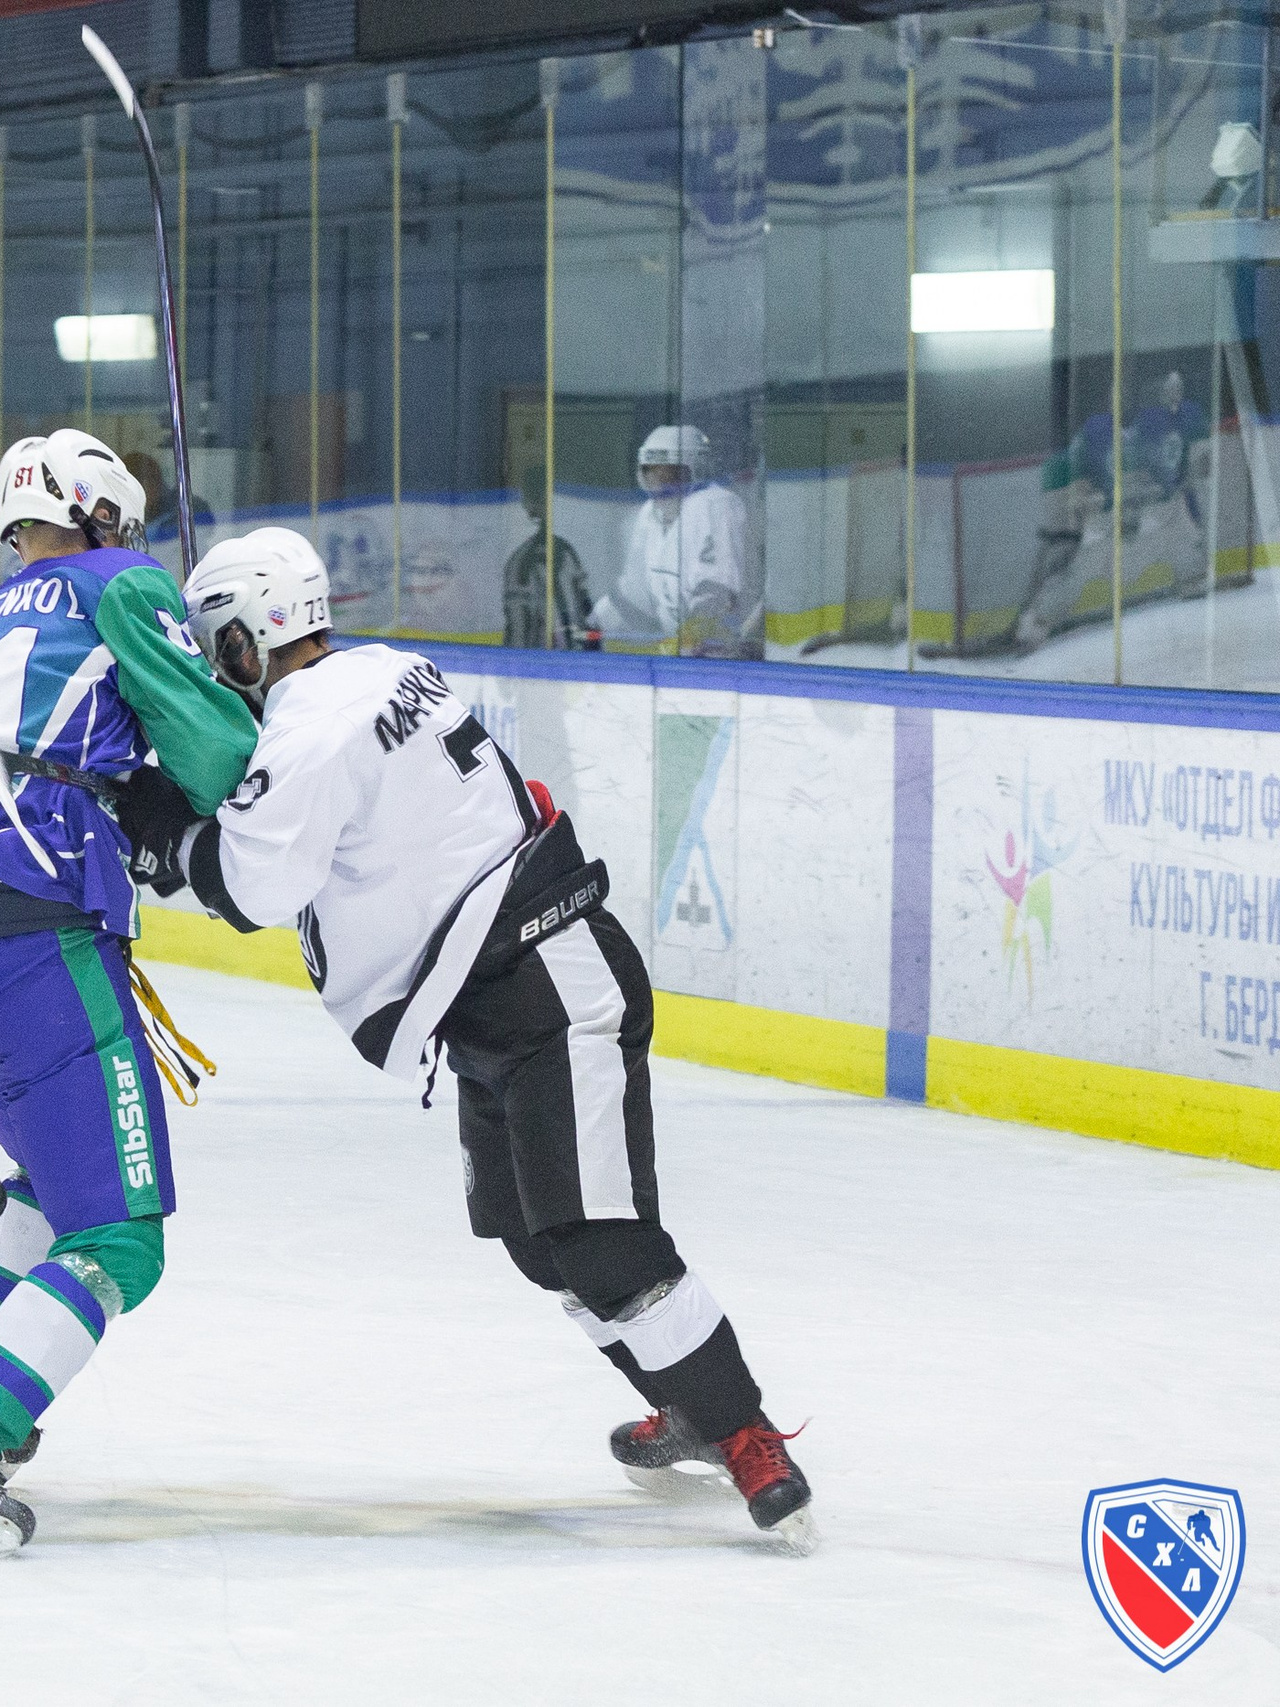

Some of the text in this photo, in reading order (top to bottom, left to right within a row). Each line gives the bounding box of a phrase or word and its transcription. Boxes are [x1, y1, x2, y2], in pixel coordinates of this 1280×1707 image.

[14, 466, 33, 489] 81
[304, 597, 326, 625] 73
[1104, 758, 1155, 827] МКУ
[1130, 861, 1260, 944] КУЛЬТУРЫ
[1200, 970, 1219, 1040] Г.
[112, 1055, 154, 1189] SibStar
